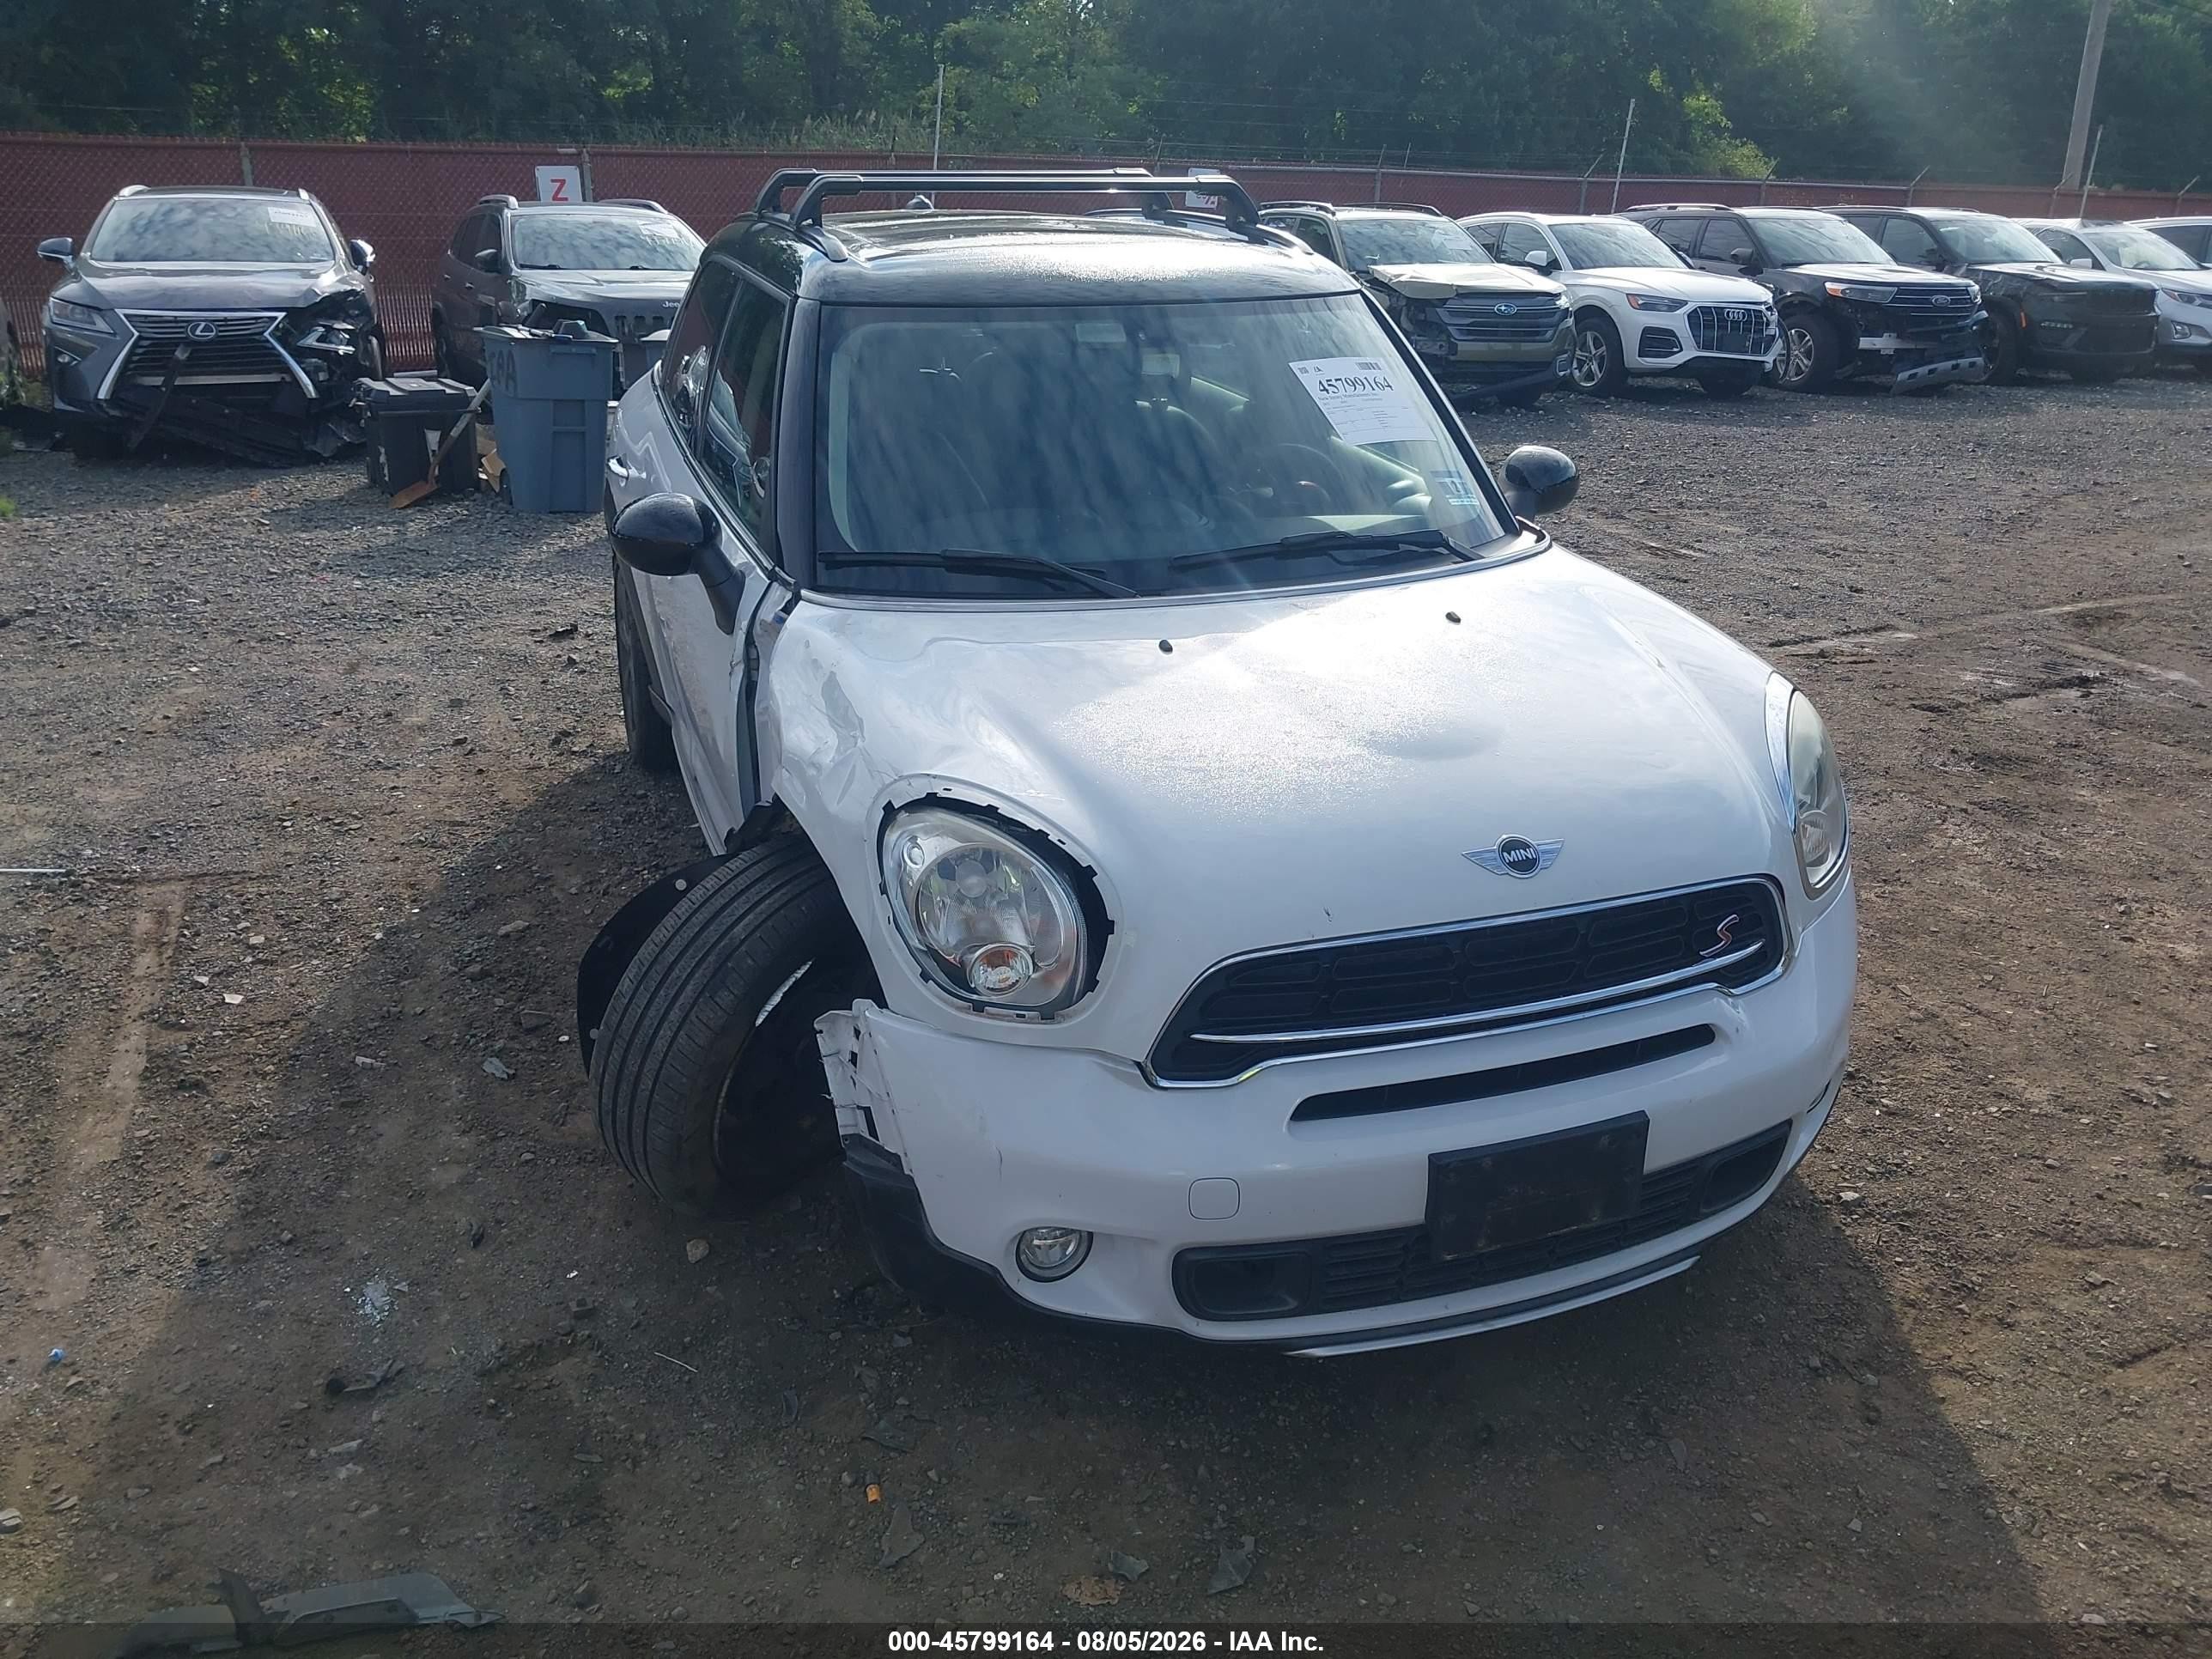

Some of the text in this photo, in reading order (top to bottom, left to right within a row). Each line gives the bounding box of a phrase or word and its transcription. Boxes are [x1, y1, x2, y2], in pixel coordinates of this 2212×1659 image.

[550, 179, 569, 202] Z
[1318, 376, 1394, 395] 45799164
[1503, 848, 1537, 864] MINI
[1699, 914, 1740, 957] S
